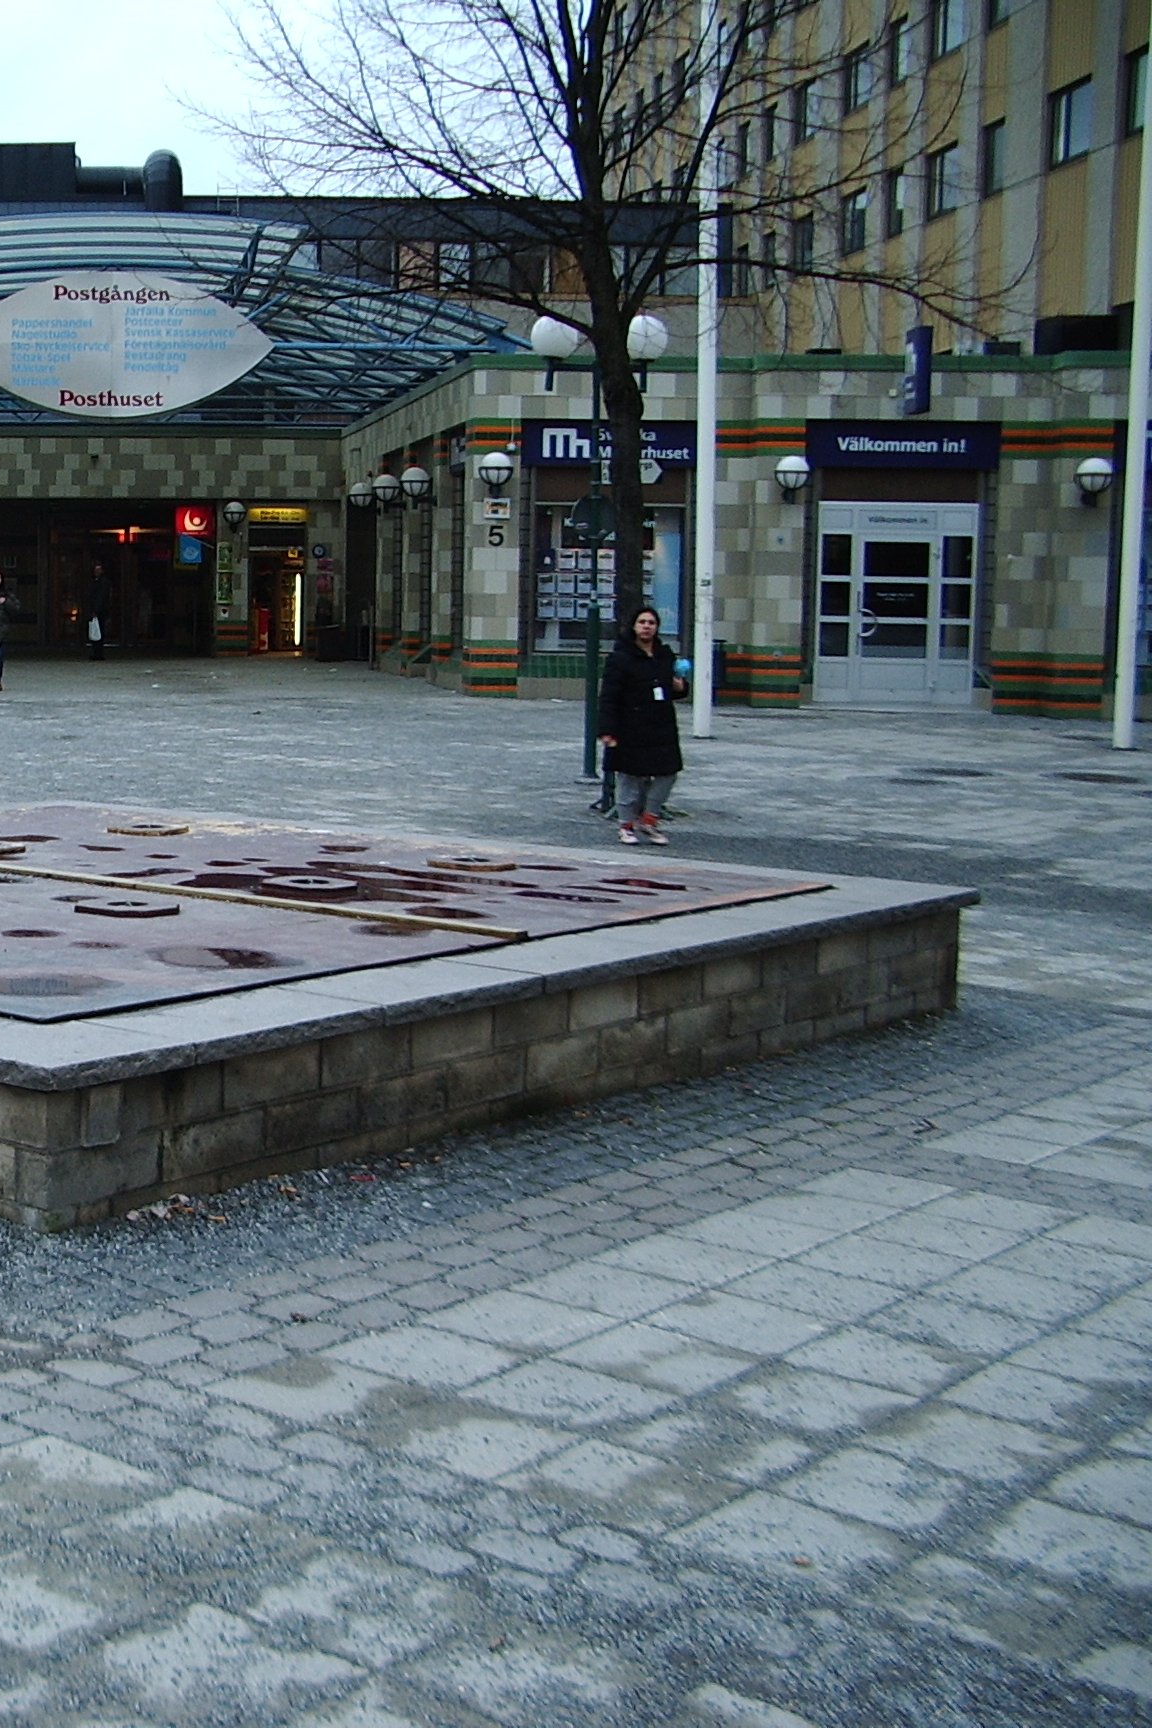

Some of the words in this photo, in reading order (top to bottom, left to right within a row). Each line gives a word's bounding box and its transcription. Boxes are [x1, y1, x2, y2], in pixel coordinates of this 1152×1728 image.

[54, 284, 170, 305] Postgången
[59, 389, 164, 407] Posthuset
[837, 436, 938, 453] Välkommen
[942, 438, 967, 453] in!
[487, 525, 505, 547] 5
